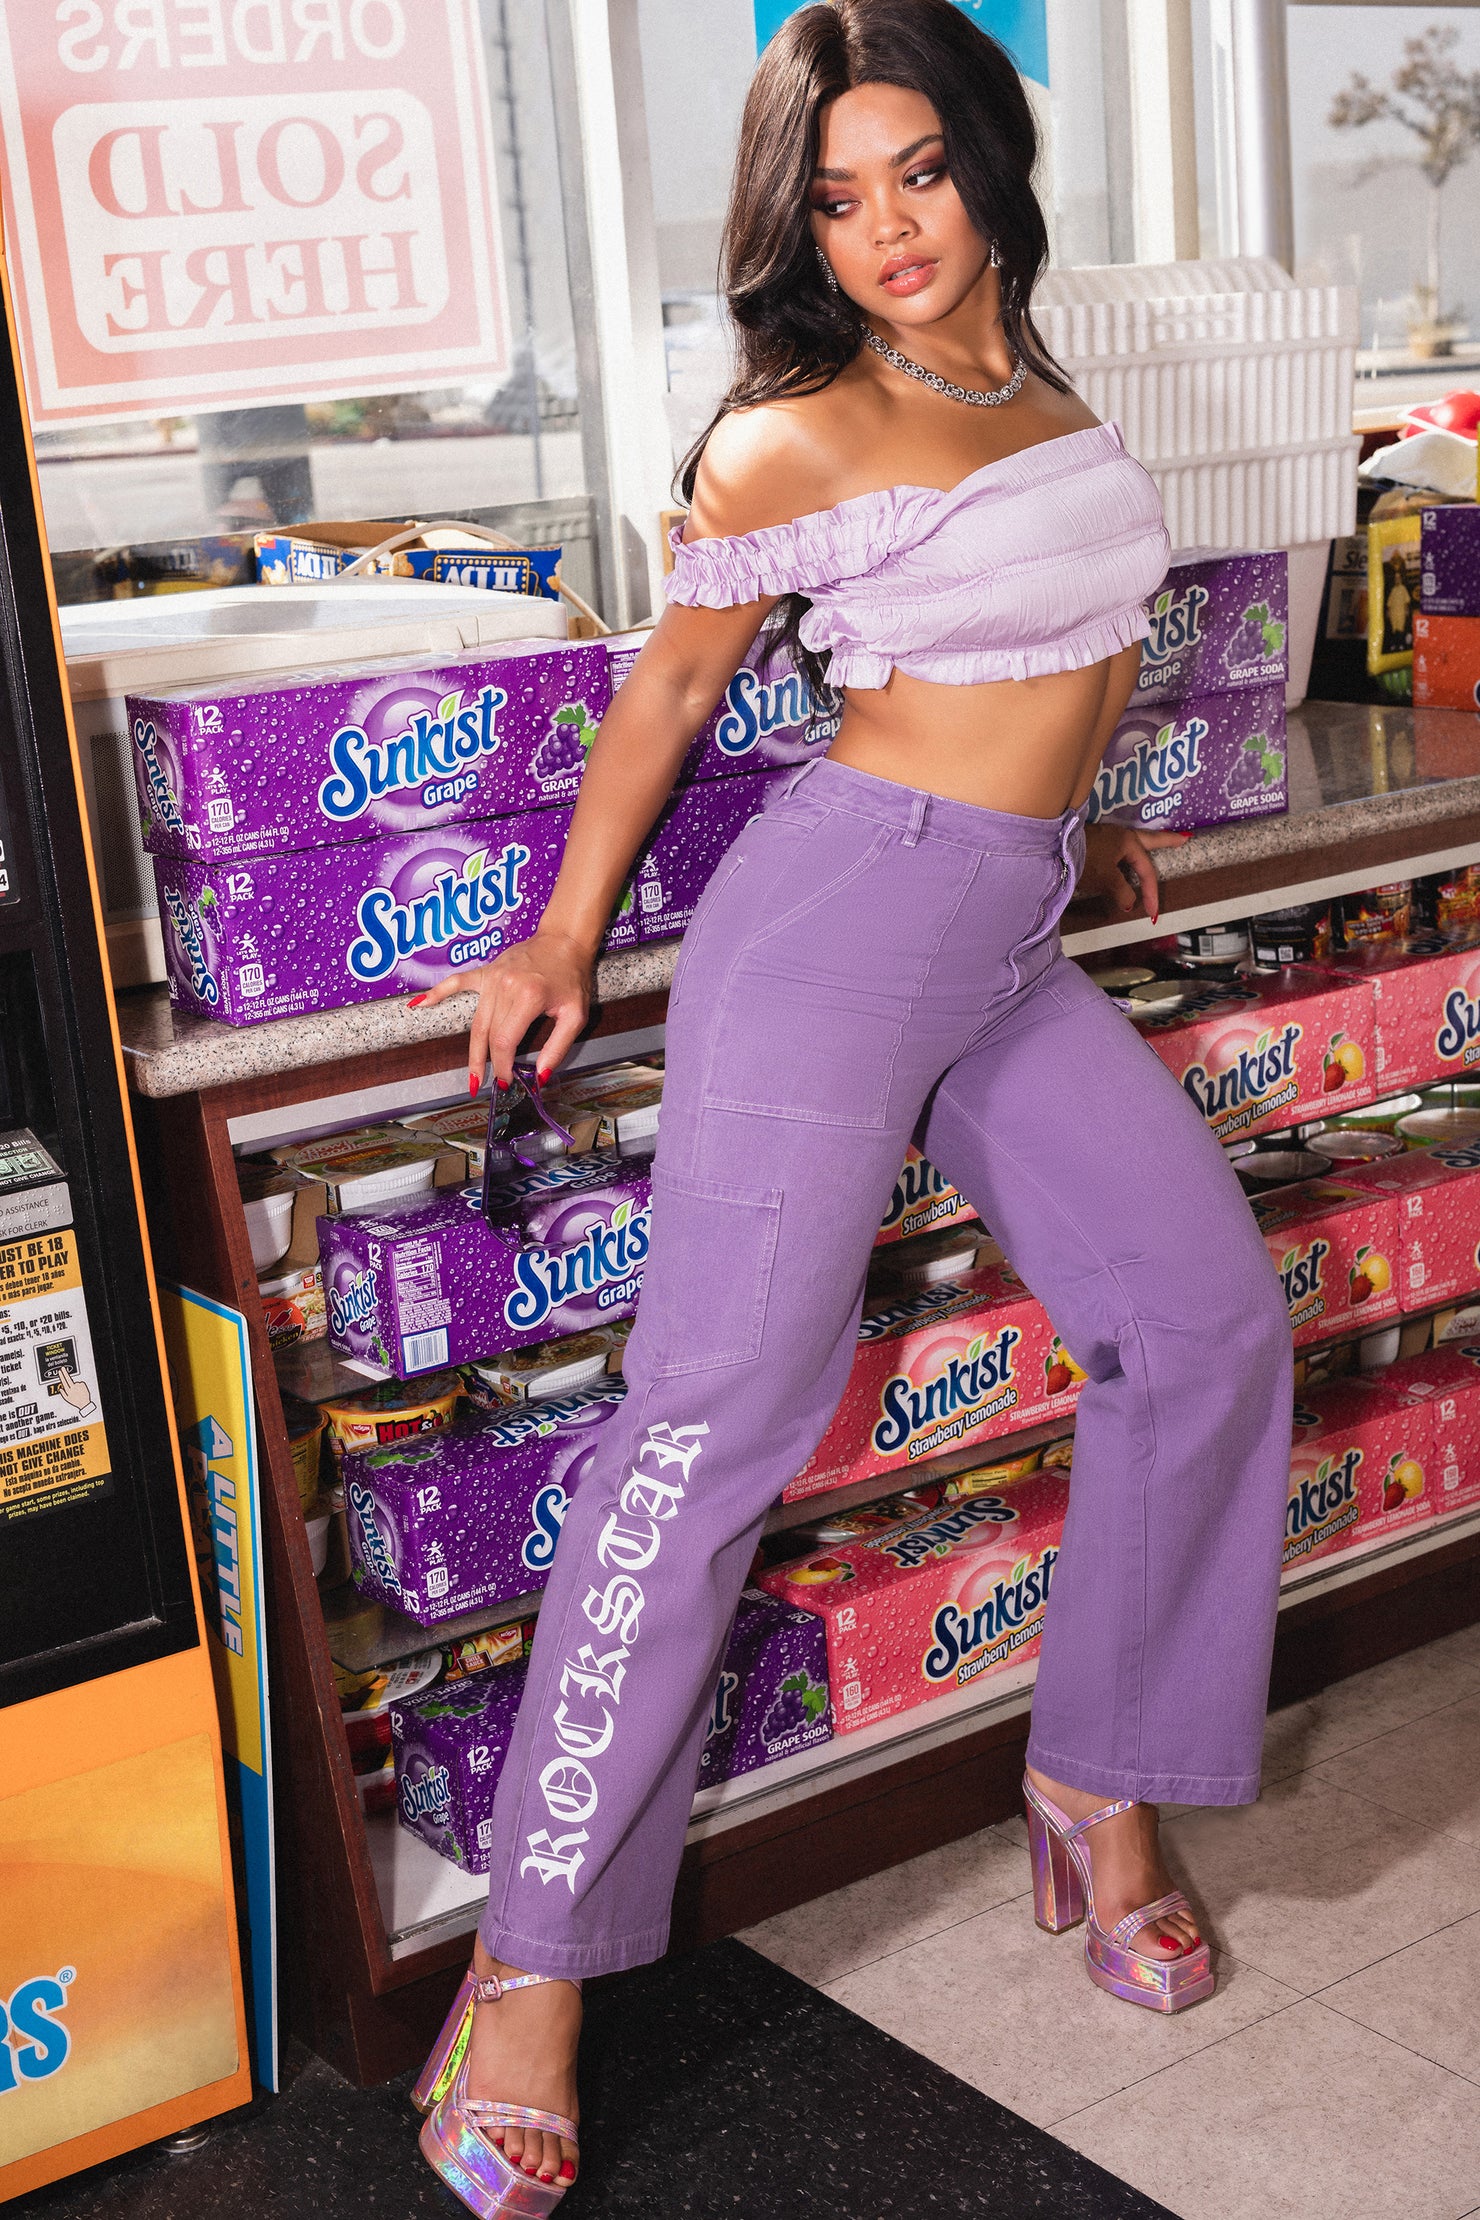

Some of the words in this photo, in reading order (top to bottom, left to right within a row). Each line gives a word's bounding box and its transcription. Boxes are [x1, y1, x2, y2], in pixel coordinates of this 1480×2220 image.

[1139, 661, 1181, 688] Grape
[1230, 666, 1259, 680] GRAPE
[1260, 662, 1284, 675] SODA
[194, 706, 222, 727] 12
[199, 725, 224, 735] PACK
[319, 685, 507, 820] Sunkist
[135, 718, 184, 835] Sunkist
[541, 777, 579, 793] GRAPE
[423, 774, 477, 805] Grape
[211, 802, 230, 816] 170
[1141, 793, 1182, 821] Grape
[1230, 796, 1259, 810] GRAPE
[1260, 791, 1284, 804] SODA
[244, 831, 259, 840] CANS
[242, 842, 257, 851] CANS
[226, 872, 252, 894] 12
[644, 884, 660, 898] 170
[230, 892, 255, 902] PACK
[348, 843, 529, 981] Sunkist
[605, 925, 635, 939] SODA
[164, 886, 218, 1005] Sunkist
[450, 930, 502, 964] Grape
[242, 967, 261, 982] 170
[273, 1004, 288, 1014] CANS
[274, 994, 290, 1005] CANS
[1183, 1022, 1303, 1117] Sunkist
[1252, 1082, 1297, 1119] Lemonade
[12, 1139, 31, 1147] Bills
[13, 1175, 28, 1183] GIVE
[29, 1170, 56, 1179] CHANGE
[570, 1171, 618, 1189] Grape
[5, 1199, 49, 1216] ASSISTANCE
[1406, 1195, 1424, 1213] 12
[902, 1194, 958, 1236] Strawberry
[8, 1226, 23, 1235] FOR
[24, 1220, 48, 1232] CLERK
[27, 1241, 44, 1257] BE
[47, 1236, 64, 1252] 18
[367, 1242, 381, 1263] 12
[18, 1259, 35, 1275] TO
[38, 1251, 69, 1271] PLAY
[370, 1261, 383, 1271] PACK
[421, 1264, 434, 1273] 170
[504, 1198, 653, 1331] Sunkis
[5, 1279, 24, 1290] deben
[24, 1275, 40, 1286] tener
[42, 1273, 50, 1281] 18
[51, 1269, 65, 1280] años
[598, 1271, 643, 1308] Grape
[8, 1290, 21, 1299] más
[22, 1286, 36, 1297] para
[37, 1282, 54, 1293] jugar.
[330, 1269, 379, 1337] Sunkist
[30, 1319, 38, 1328] or
[40, 1315, 53, 1325] $20
[54, 1310, 73, 1321] bills.
[359, 1314, 377, 1333] Grape
[45, 1348, 65, 1356] WINDOW
[1, 1361, 22, 1374] ticket
[873, 1326, 1022, 1455] Sunkist
[18, 1404, 35, 1415] OUT
[1009, 1401, 1051, 1422] STRAWBERRY
[1440, 1399, 1456, 1415] 12
[5, 1416, 34, 1431] another
[35, 1411, 57, 1424] game.
[378, 1419, 422, 1444] HOT
[908, 1419, 964, 1460] Strawberry
[965, 1386, 1017, 1428] Lemonade
[16, 1438, 62, 1459] MACHINE
[64, 1430, 90, 1446] DOES
[211, 1415, 234, 1459] A
[0, 1462, 18, 1477] NOT
[22, 1456, 44, 1471] GIVE
[46, 1444, 85, 1464] CHANGE
[3, 1489, 11, 1498] No
[12, 1483, 31, 1495] acepta
[33, 1477, 55, 1489] moneda
[56, 1468, 87, 1483] extranjera.
[5, 1476, 18, 1486] Esta
[19, 1470, 42, 1482] máquina
[52, 1465, 59, 1473] da
[60, 1459, 82, 1471] cambio.
[6, 1503, 20, 1514] game
[21, 1499, 36, 1507] start,
[37, 1495, 51, 1504] some
[52, 1490, 70, 1499] prizes,
[71, 1482, 95, 1494] including
[416, 1485, 440, 1508] 12
[1284, 1447, 1364, 1540] nkist
[8, 1509, 27, 1519] prizes,
[28, 1505, 39, 1514] may
[40, 1501, 52, 1509] have
[53, 1497, 67, 1505] been
[67, 1491, 90, 1501] claimed.
[420, 1502, 442, 1515] PACK
[882, 1497, 1019, 1569] Sunkist
[1313, 1505, 1358, 1544] Lemonade
[350, 1482, 402, 1596] Sunkist
[214, 1477, 243, 1657] LITTLE
[361, 1541, 377, 1577] Grape
[429, 1570, 446, 1584] 170
[836, 1607, 855, 1627] 12
[924, 1546, 1059, 1683] Sunkist
[839, 1625, 857, 1634] PACK
[464, 1654, 480, 1663] CHILI
[465, 1659, 484, 1668] SAUCE
[521, 1419, 711, 1896] ROCKSTAR
[957, 1640, 1009, 1685] Strawberry
[438, 1679, 473, 1695] GRAPE
[845, 1684, 859, 1697] 160
[402, 1693, 435, 1706] SODA
[390, 1711, 403, 1730] 12
[768, 1736, 800, 1755] GRAPE
[802, 1724, 829, 1742] SODA
[467, 1746, 490, 1768] 12
[471, 1762, 492, 1774] PACK
[401, 1766, 451, 1821] Sunkist
[433, 1812, 449, 1825] Grape
